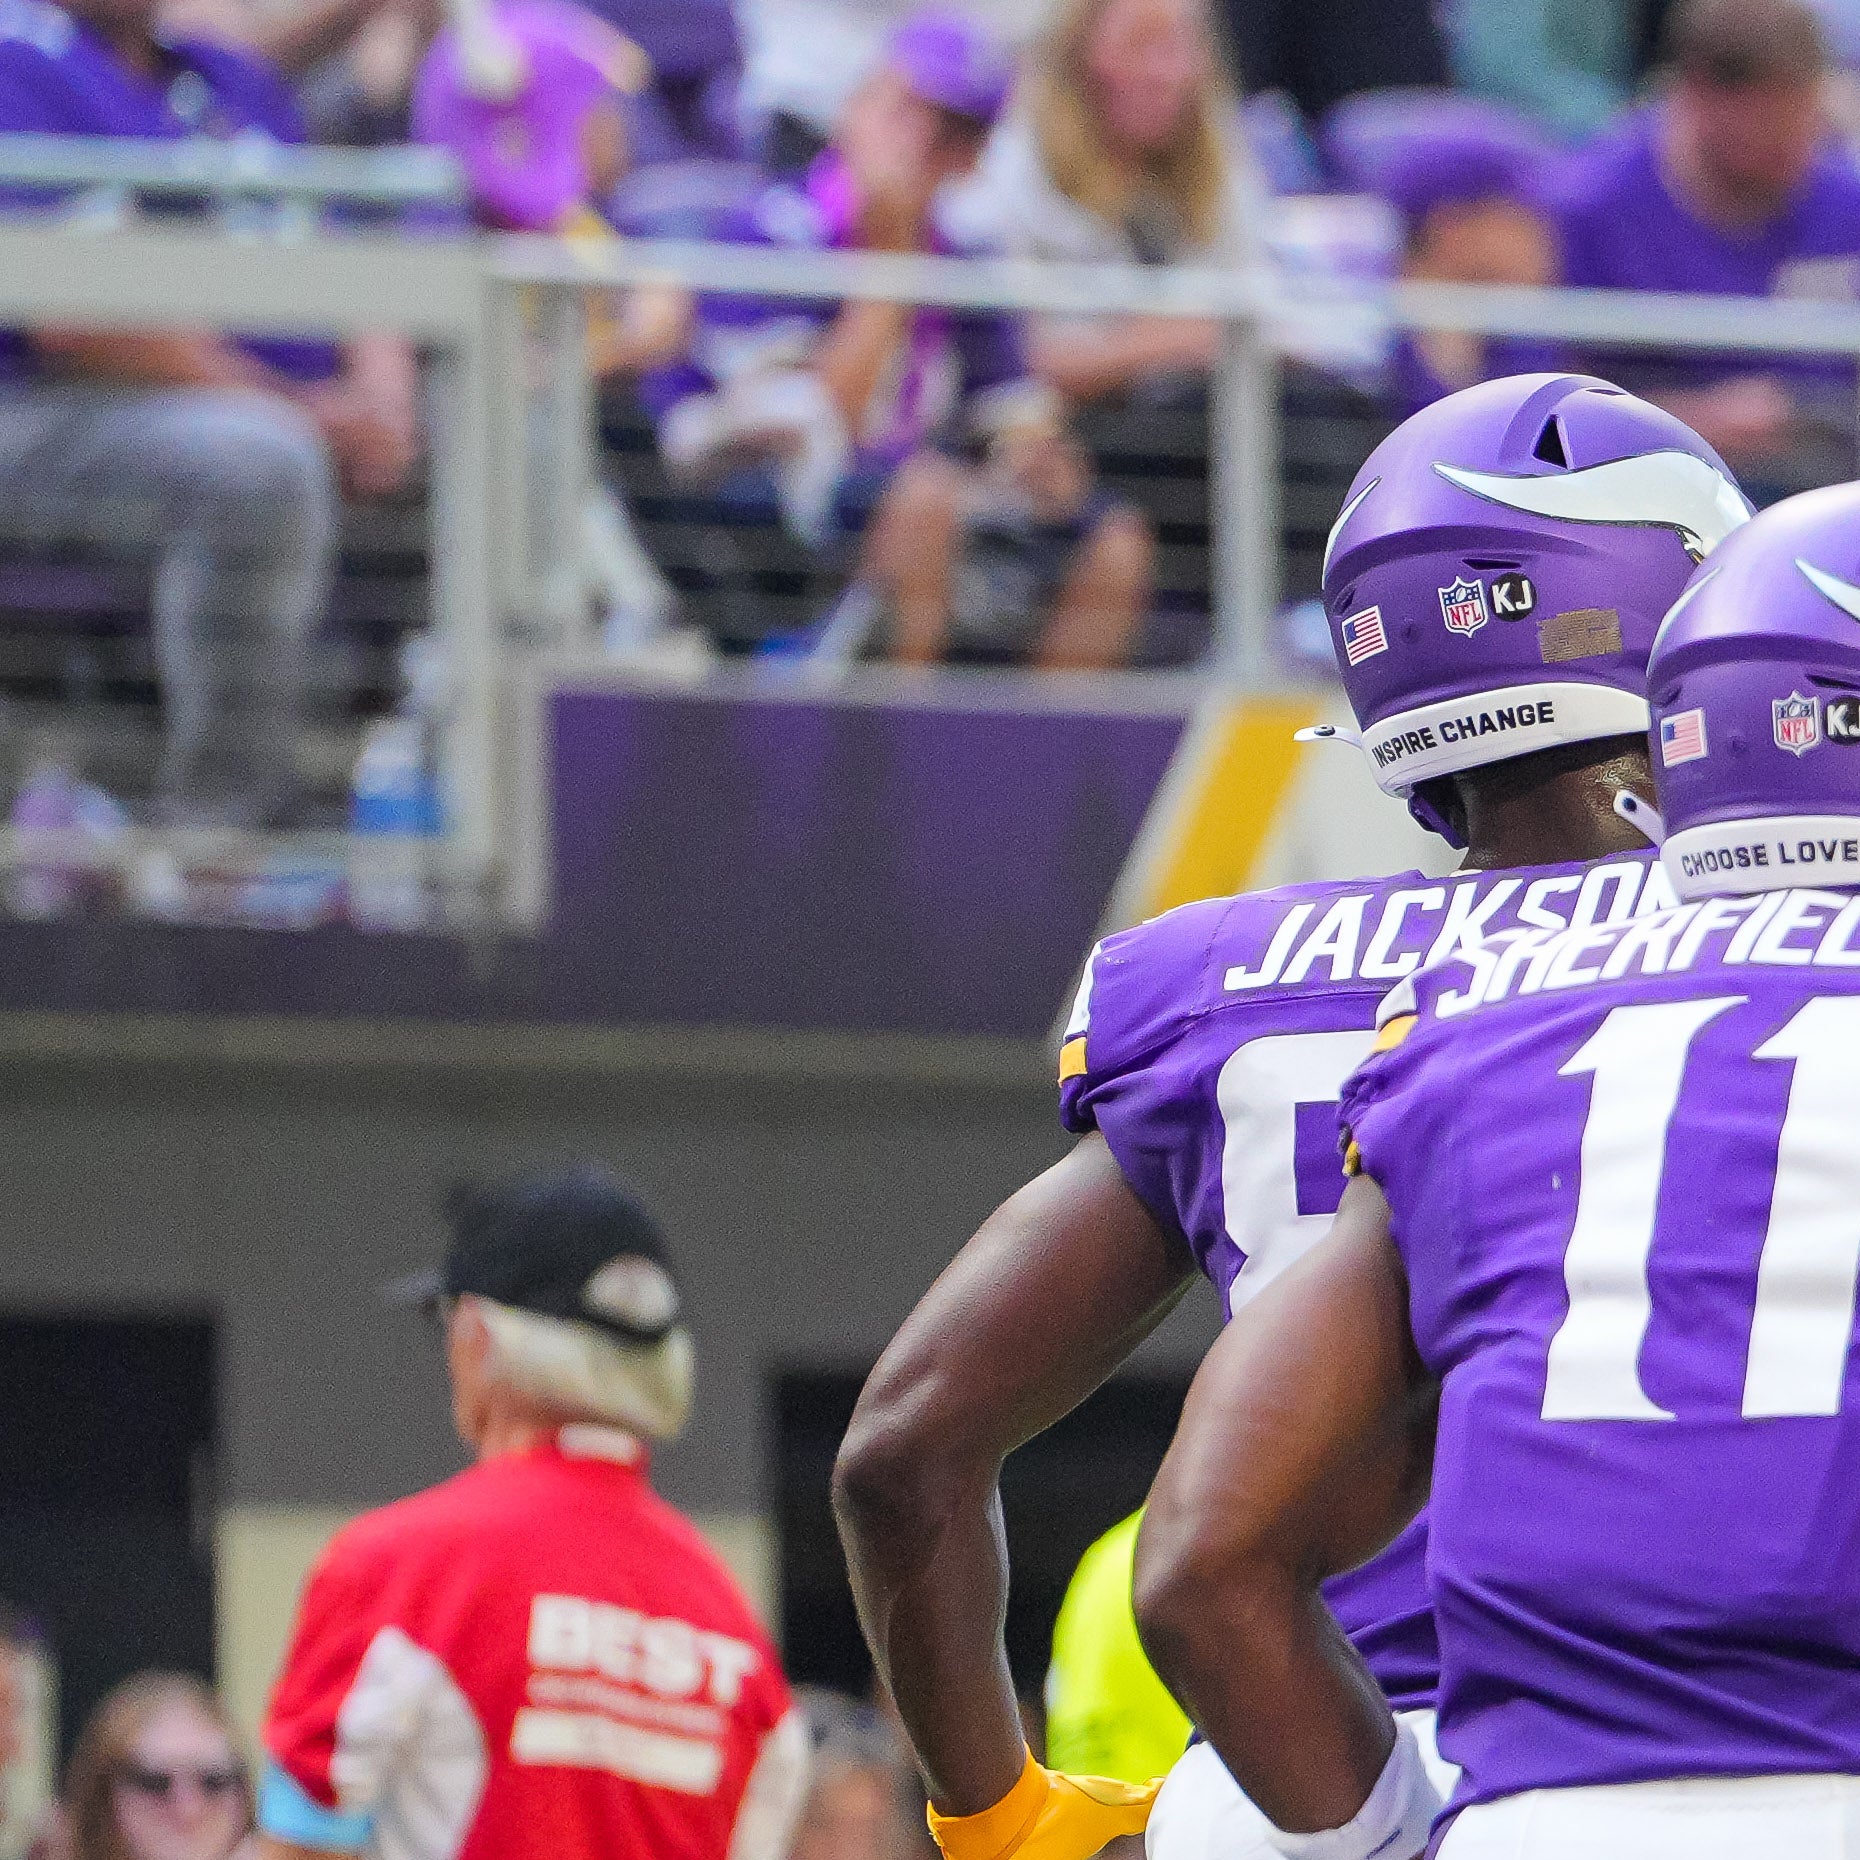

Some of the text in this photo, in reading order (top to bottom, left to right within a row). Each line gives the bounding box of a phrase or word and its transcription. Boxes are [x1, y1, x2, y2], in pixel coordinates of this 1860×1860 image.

[1448, 602, 1483, 627] NFL
[1492, 579, 1533, 613] KJ
[1371, 701, 1555, 770] INSPIRE CHANGE
[1779, 718, 1814, 742] NFL
[1681, 839, 1859, 879] CHOOSE LOVE
[527, 1592, 762, 1704] BEST
